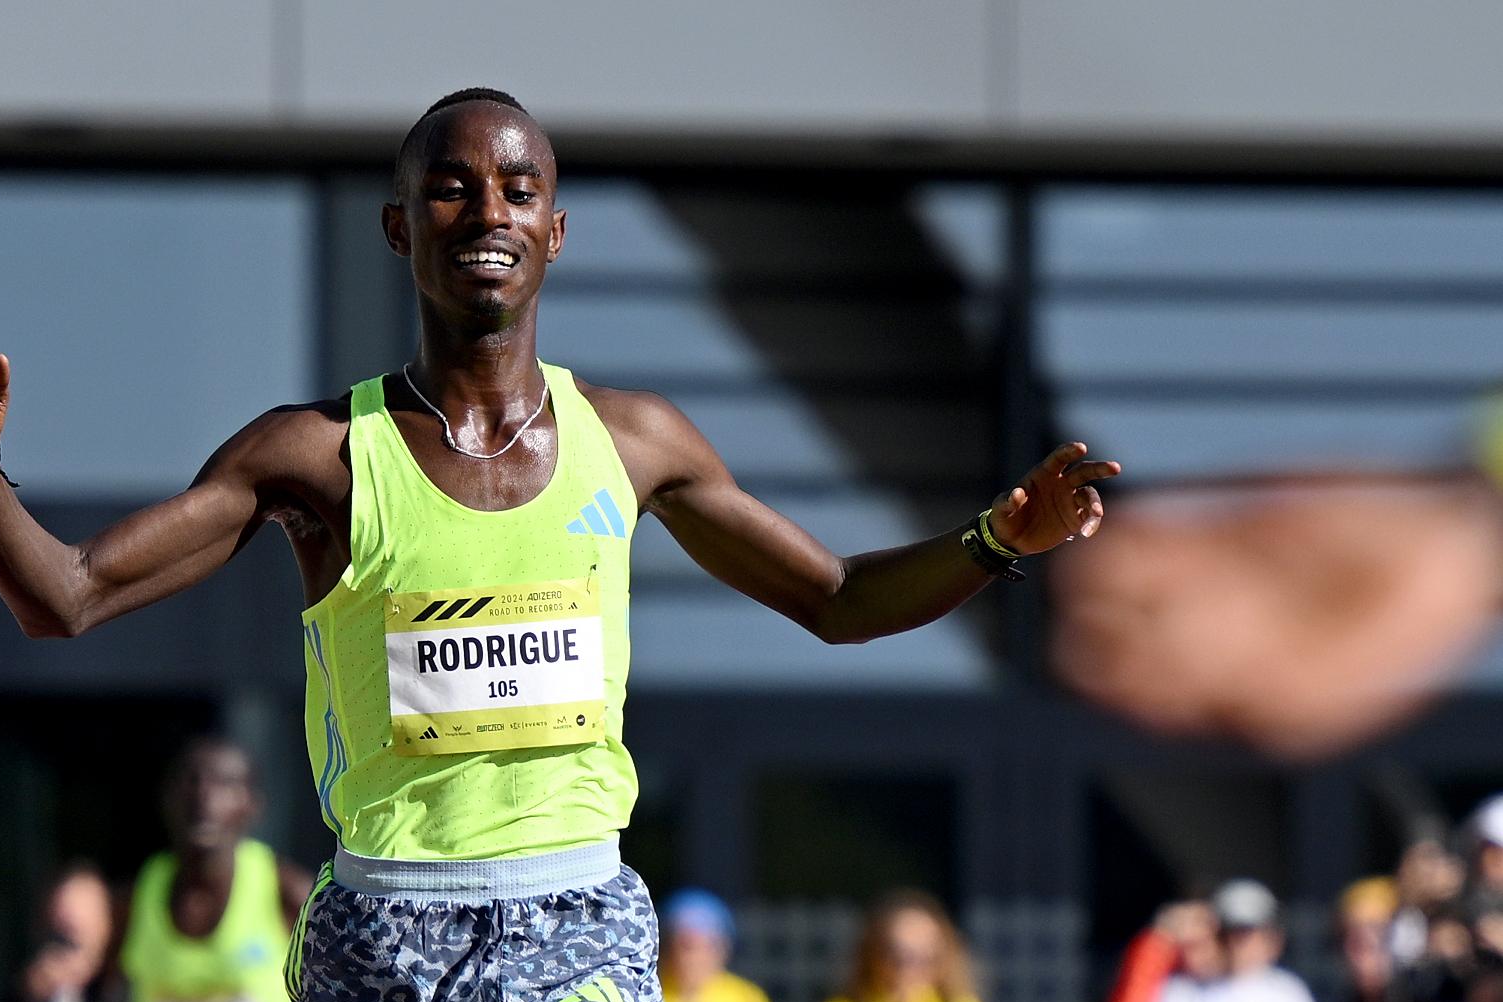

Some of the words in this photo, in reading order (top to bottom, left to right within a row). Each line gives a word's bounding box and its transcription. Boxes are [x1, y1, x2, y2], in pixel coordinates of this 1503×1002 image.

[501, 594, 523, 604] 2024
[527, 591, 562, 602] ADIZERO
[489, 607, 511, 617] ROAD
[515, 606, 525, 615] TO
[528, 603, 563, 613] RECORDS
[417, 628, 579, 674] RODRIGUE
[487, 679, 518, 698] 105
